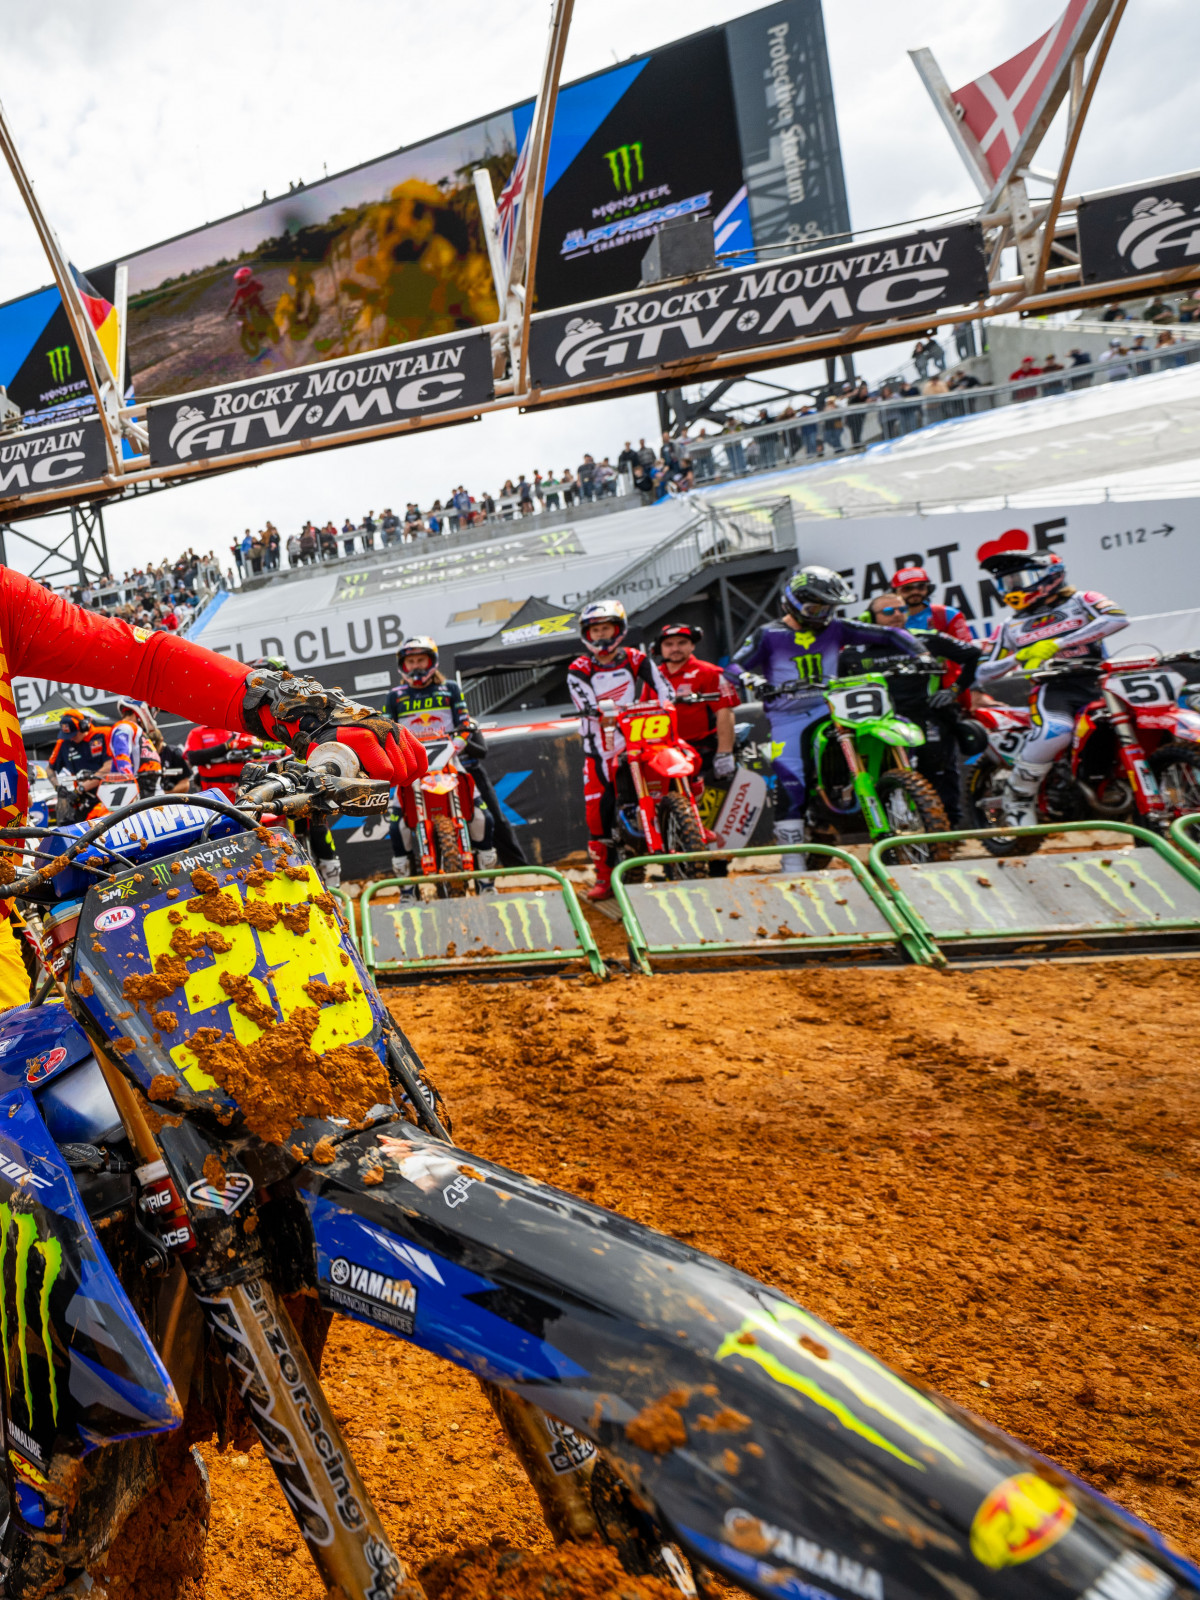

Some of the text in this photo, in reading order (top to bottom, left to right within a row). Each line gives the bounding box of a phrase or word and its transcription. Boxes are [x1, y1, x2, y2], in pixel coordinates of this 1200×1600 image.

[767, 21, 808, 205] Protective Stadium
[592, 183, 672, 219] MONSTER
[610, 237, 949, 331] ROCKY MOUNTAIN
[39, 379, 90, 402] MONSTER
[209, 345, 466, 419] ROCKY MOUNTAIN
[1100, 528, 1147, 551] C112
[294, 613, 404, 664] CLUB
[403, 696, 444, 711] THOR
[1120, 675, 1176, 704] 51
[845, 690, 885, 721] 9
[628, 715, 671, 743] 18
[109, 786, 128, 808] 1
[341, 792, 390, 808] ARC
[721, 781, 751, 836] HONDA
[736, 806, 761, 837] HRC
[101, 881, 138, 904] SMX
[102, 908, 130, 928] AMA
[350, 1264, 417, 1314] YAMAHA
[329, 1288, 413, 1335] FINANCIAL SERVICES
[7, 1417, 43, 1461] YAMALUBE
